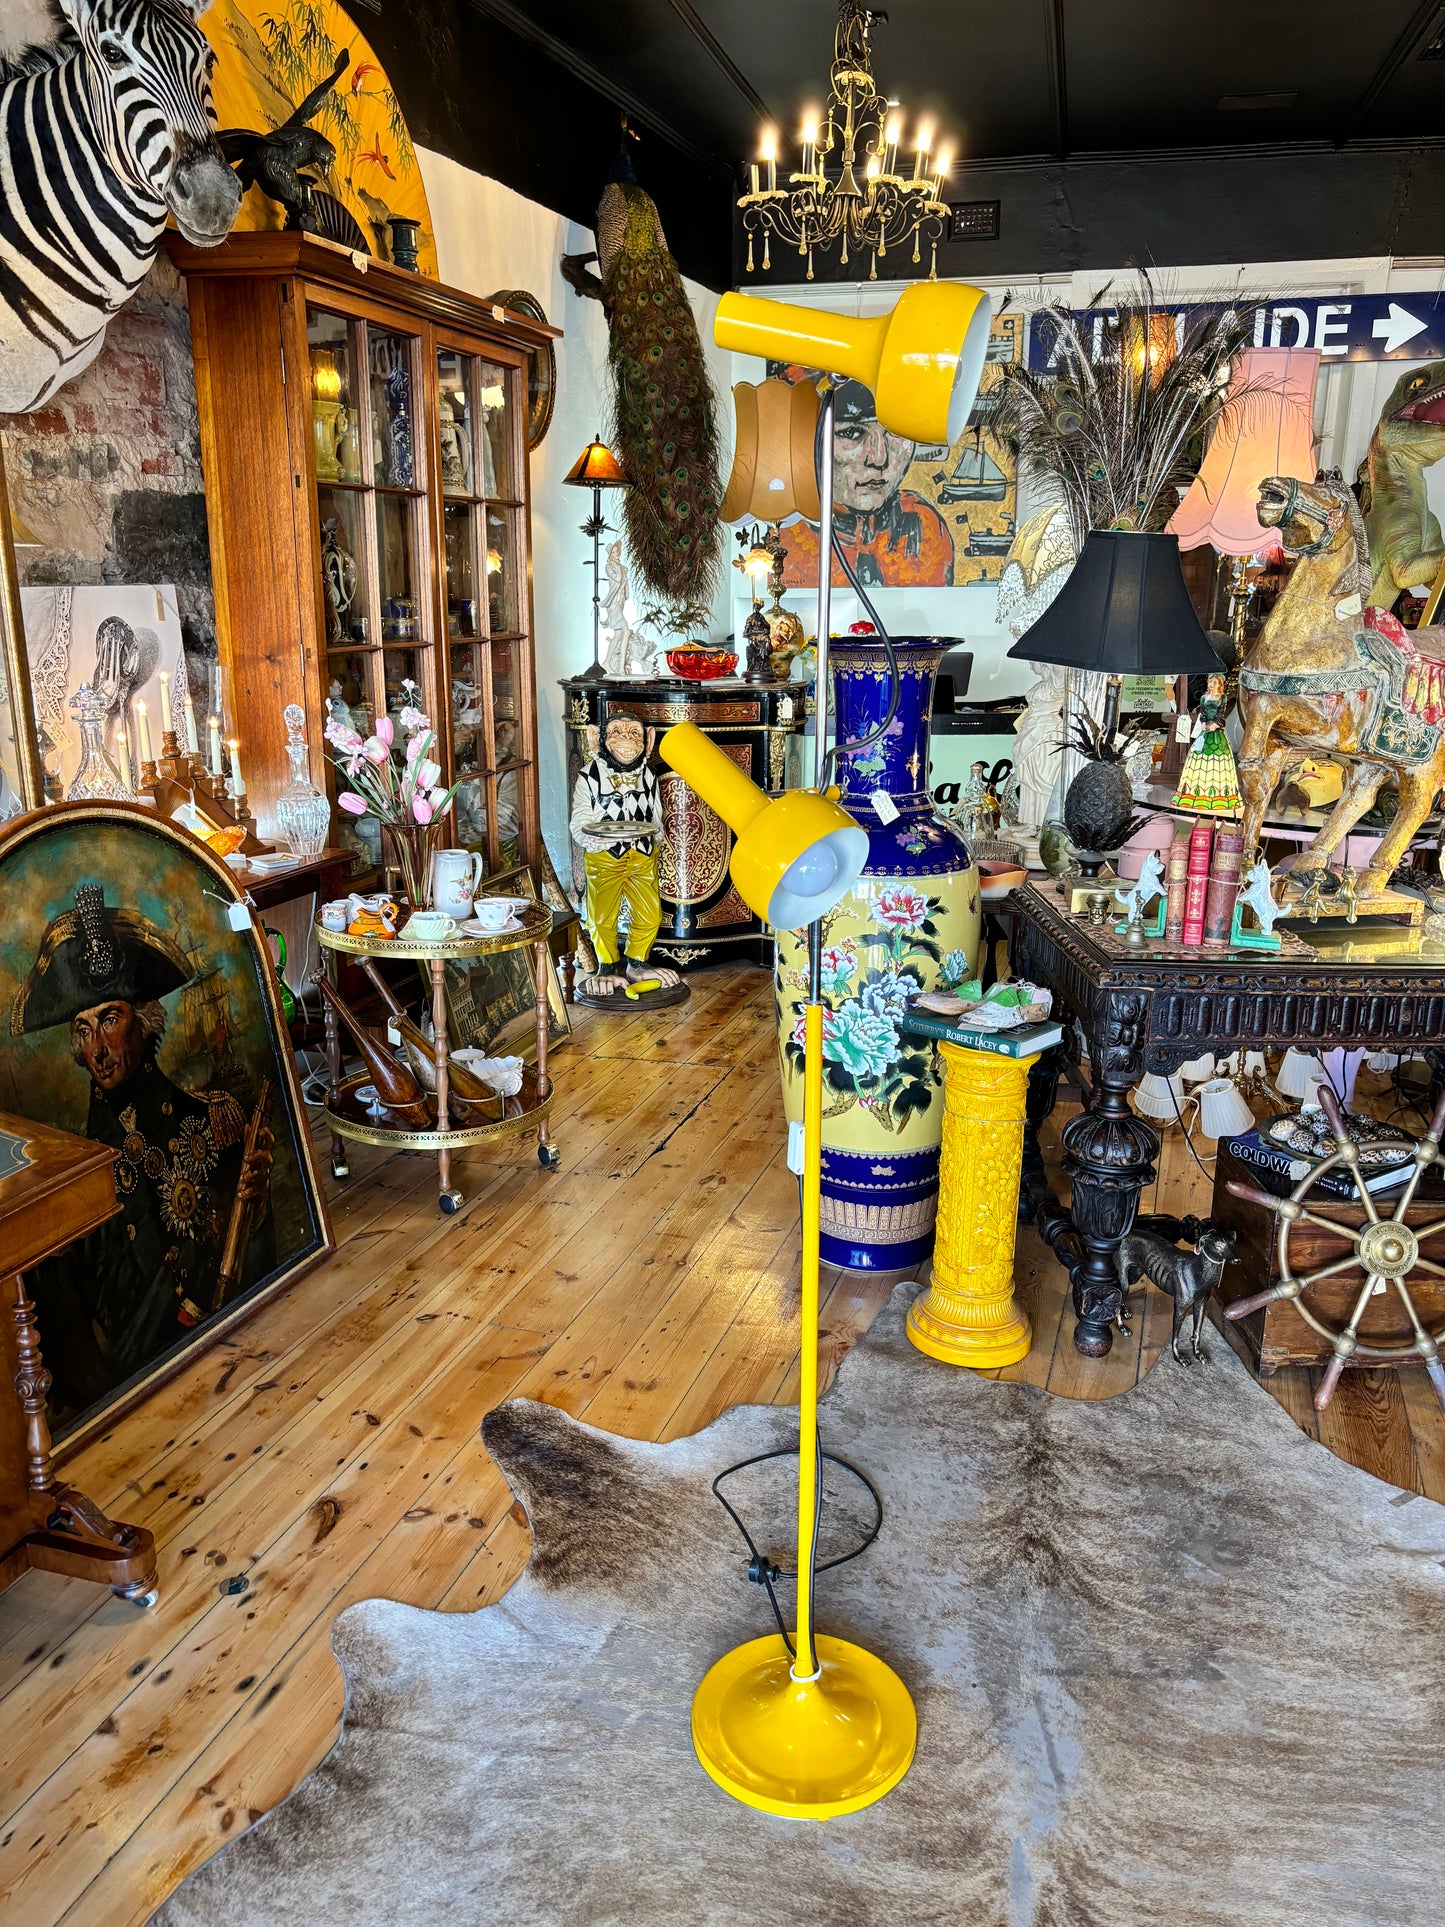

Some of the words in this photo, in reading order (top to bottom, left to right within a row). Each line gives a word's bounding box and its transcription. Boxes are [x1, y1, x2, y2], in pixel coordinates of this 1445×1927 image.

[1046, 304, 1352, 369] AAIDE
[946, 1029, 974, 1045] ROBERT
[974, 1036, 998, 1051] LACEY
[1229, 1141, 1270, 1168] COLD
[1270, 1154, 1291, 1176] WA
